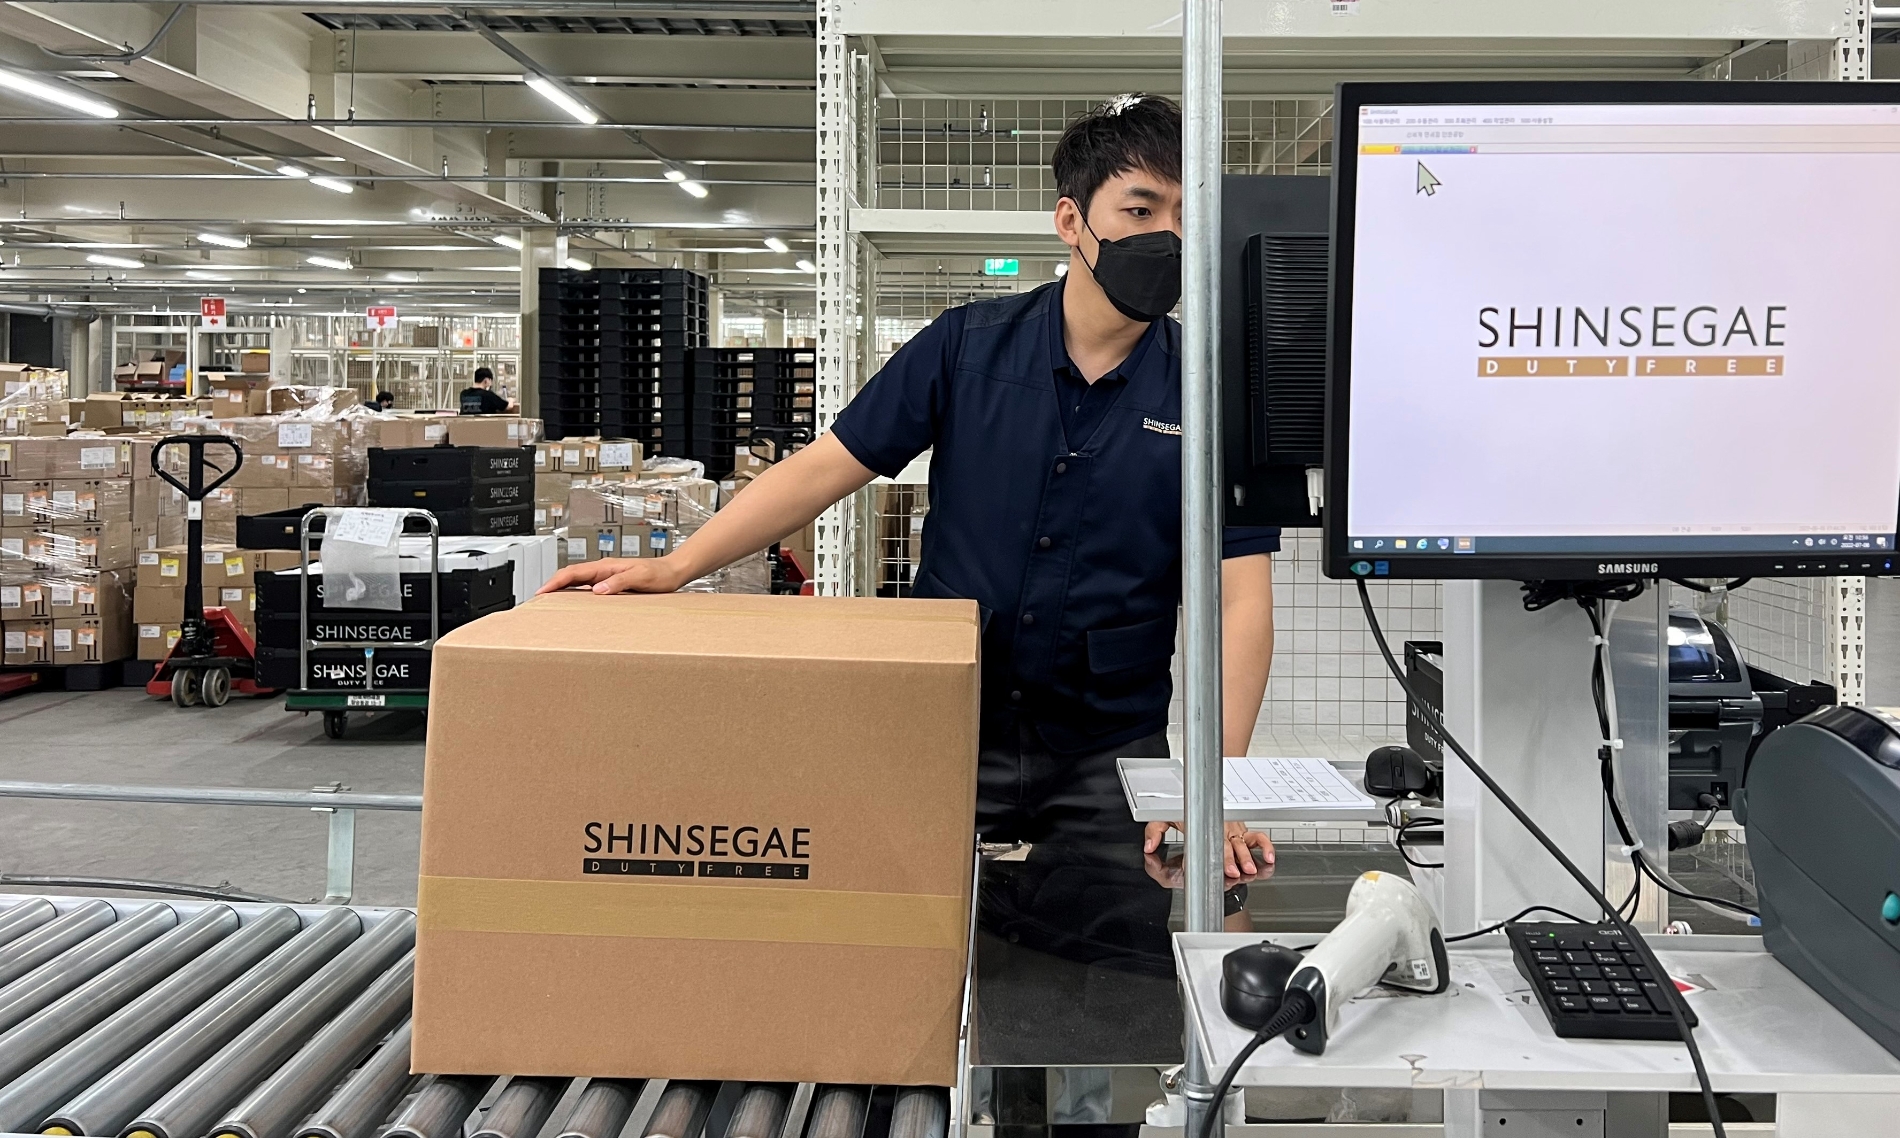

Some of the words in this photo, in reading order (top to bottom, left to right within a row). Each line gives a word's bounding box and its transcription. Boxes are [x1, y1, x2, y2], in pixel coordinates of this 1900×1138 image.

[1478, 305, 1787, 348] SHINSEGAE
[1485, 359, 1618, 374] DUTY
[1646, 359, 1776, 373] FREE
[1143, 417, 1182, 431] SHINSEGA
[1598, 563, 1658, 574] SAMSUNG
[316, 625, 412, 639] SHINSEGAE
[313, 664, 409, 678] SHINSGAE
[1424, 732, 1438, 749] DUTY
[584, 821, 810, 858] SHINSEGAE
[591, 861, 686, 874] DUTY
[706, 865, 801, 877] FREE
